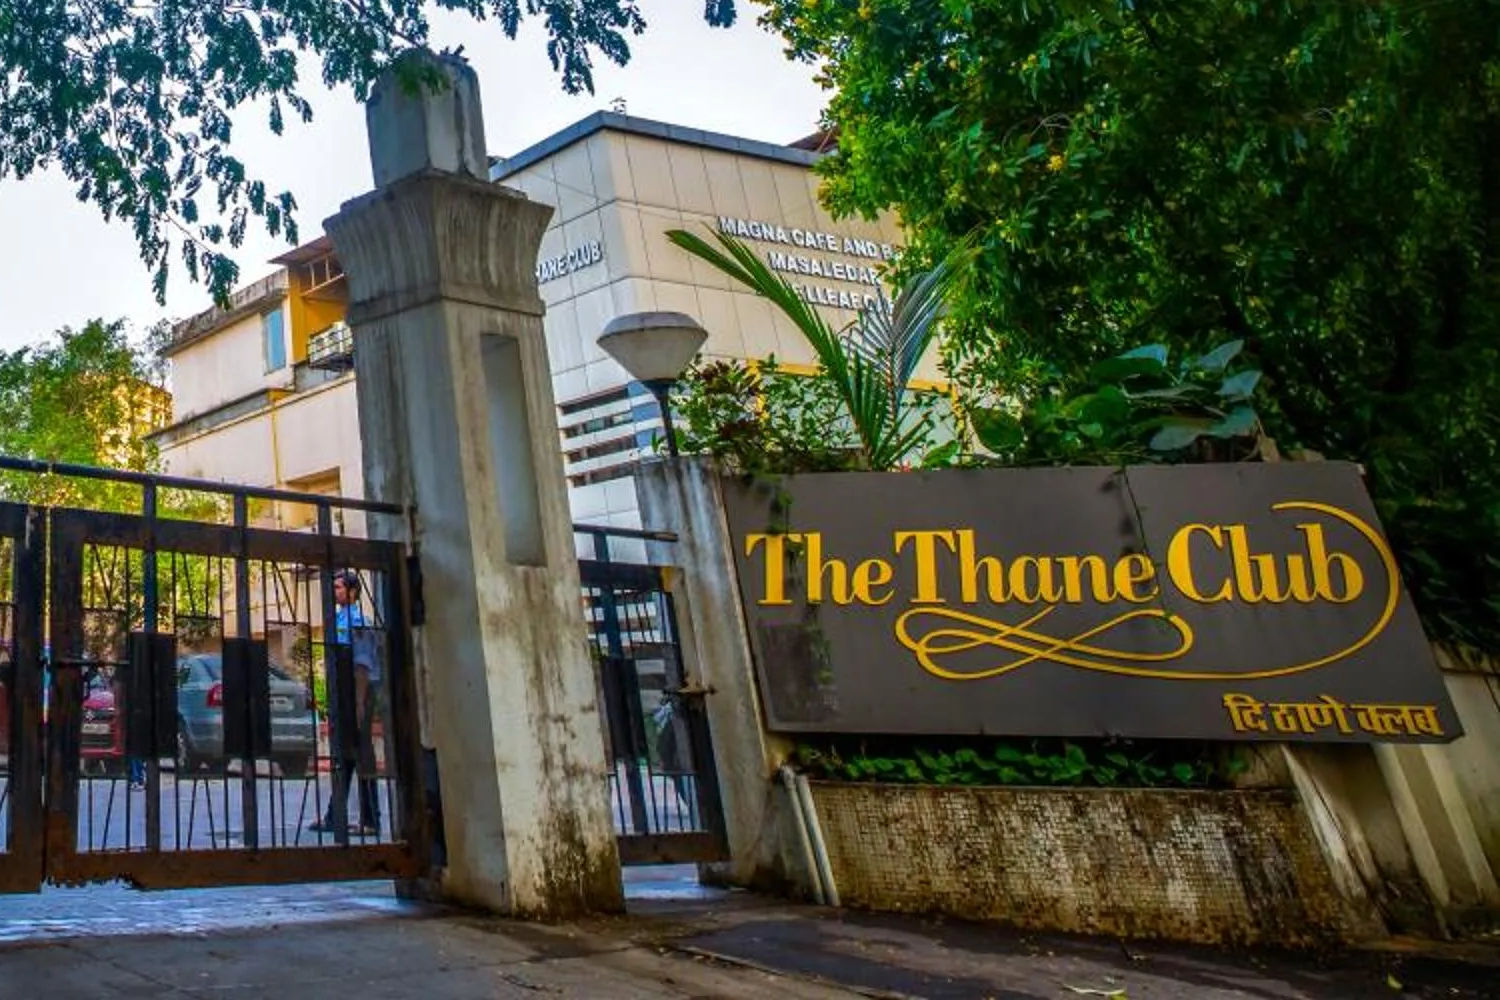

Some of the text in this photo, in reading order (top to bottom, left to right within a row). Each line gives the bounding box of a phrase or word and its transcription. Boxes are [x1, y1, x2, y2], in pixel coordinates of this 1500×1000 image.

[567, 240, 604, 273] CLUB
[718, 215, 789, 244] MAGNA
[790, 228, 838, 251] CAFE
[842, 237, 879, 259] AND
[768, 251, 884, 287] MASALEDAR
[745, 521, 1365, 605] The Thane Club
[1222, 692, 1268, 734] दि
[1269, 693, 1352, 735] ठाणे
